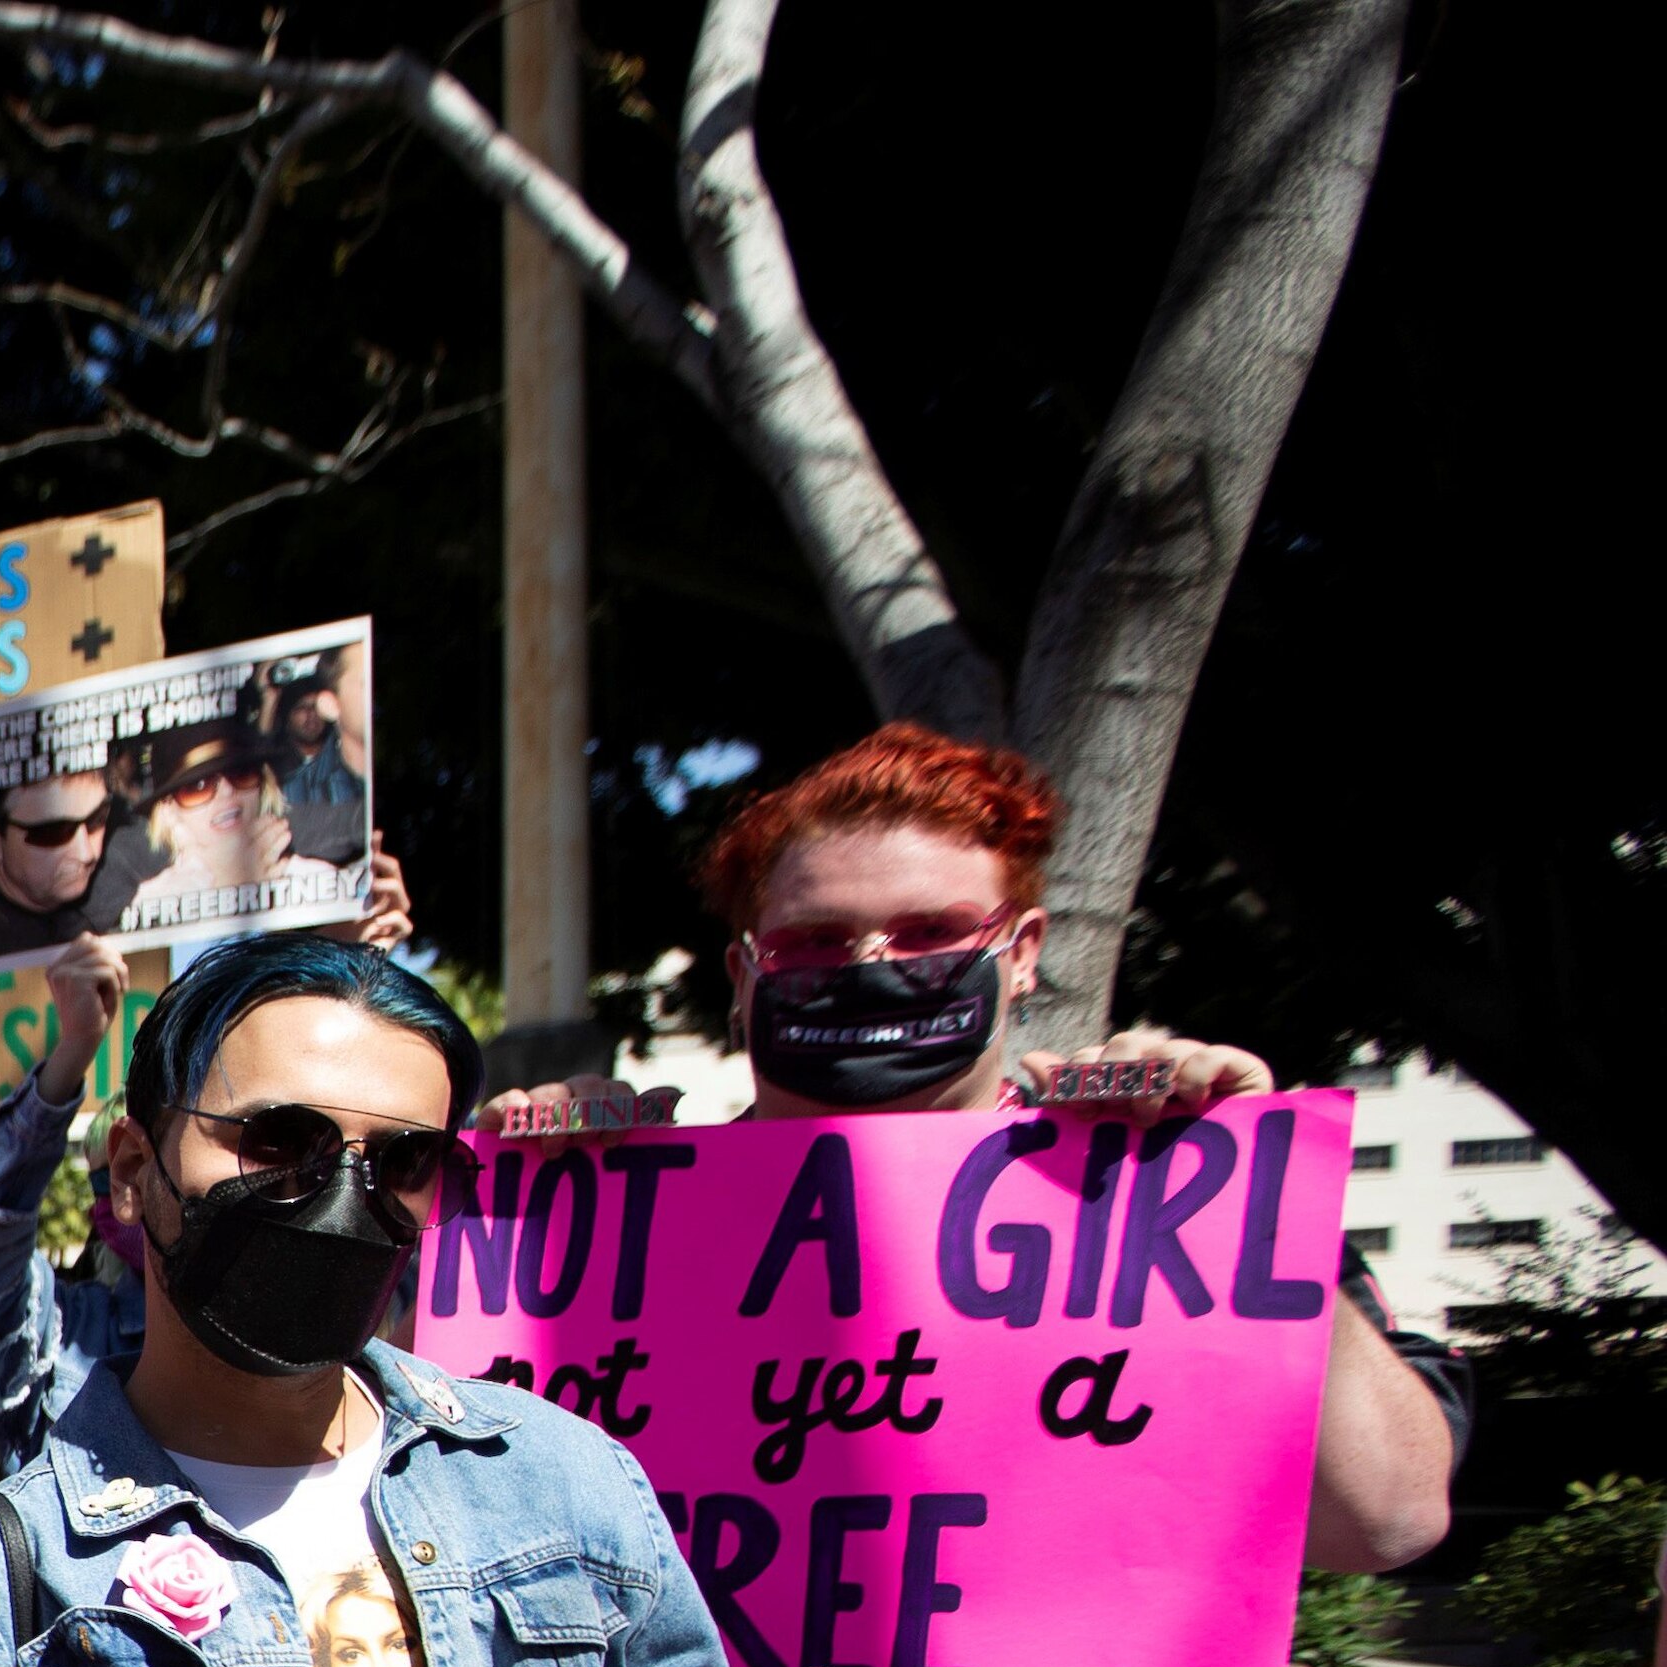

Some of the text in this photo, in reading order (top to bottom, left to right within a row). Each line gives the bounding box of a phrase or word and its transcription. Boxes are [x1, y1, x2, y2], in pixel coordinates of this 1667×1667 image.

[38, 719, 114, 757] THERE
[118, 709, 144, 738] IS
[146, 690, 238, 735] SMOKE
[40, 663, 254, 729] CONSERVATORSHIP
[119, 867, 362, 933] #FREEBRITNEY
[498, 1090, 685, 1138] BRITNEY
[430, 1108, 1325, 1330] NOT A GIRL
[750, 1327, 946, 1485] yet
[1038, 1348, 1154, 1445] a
